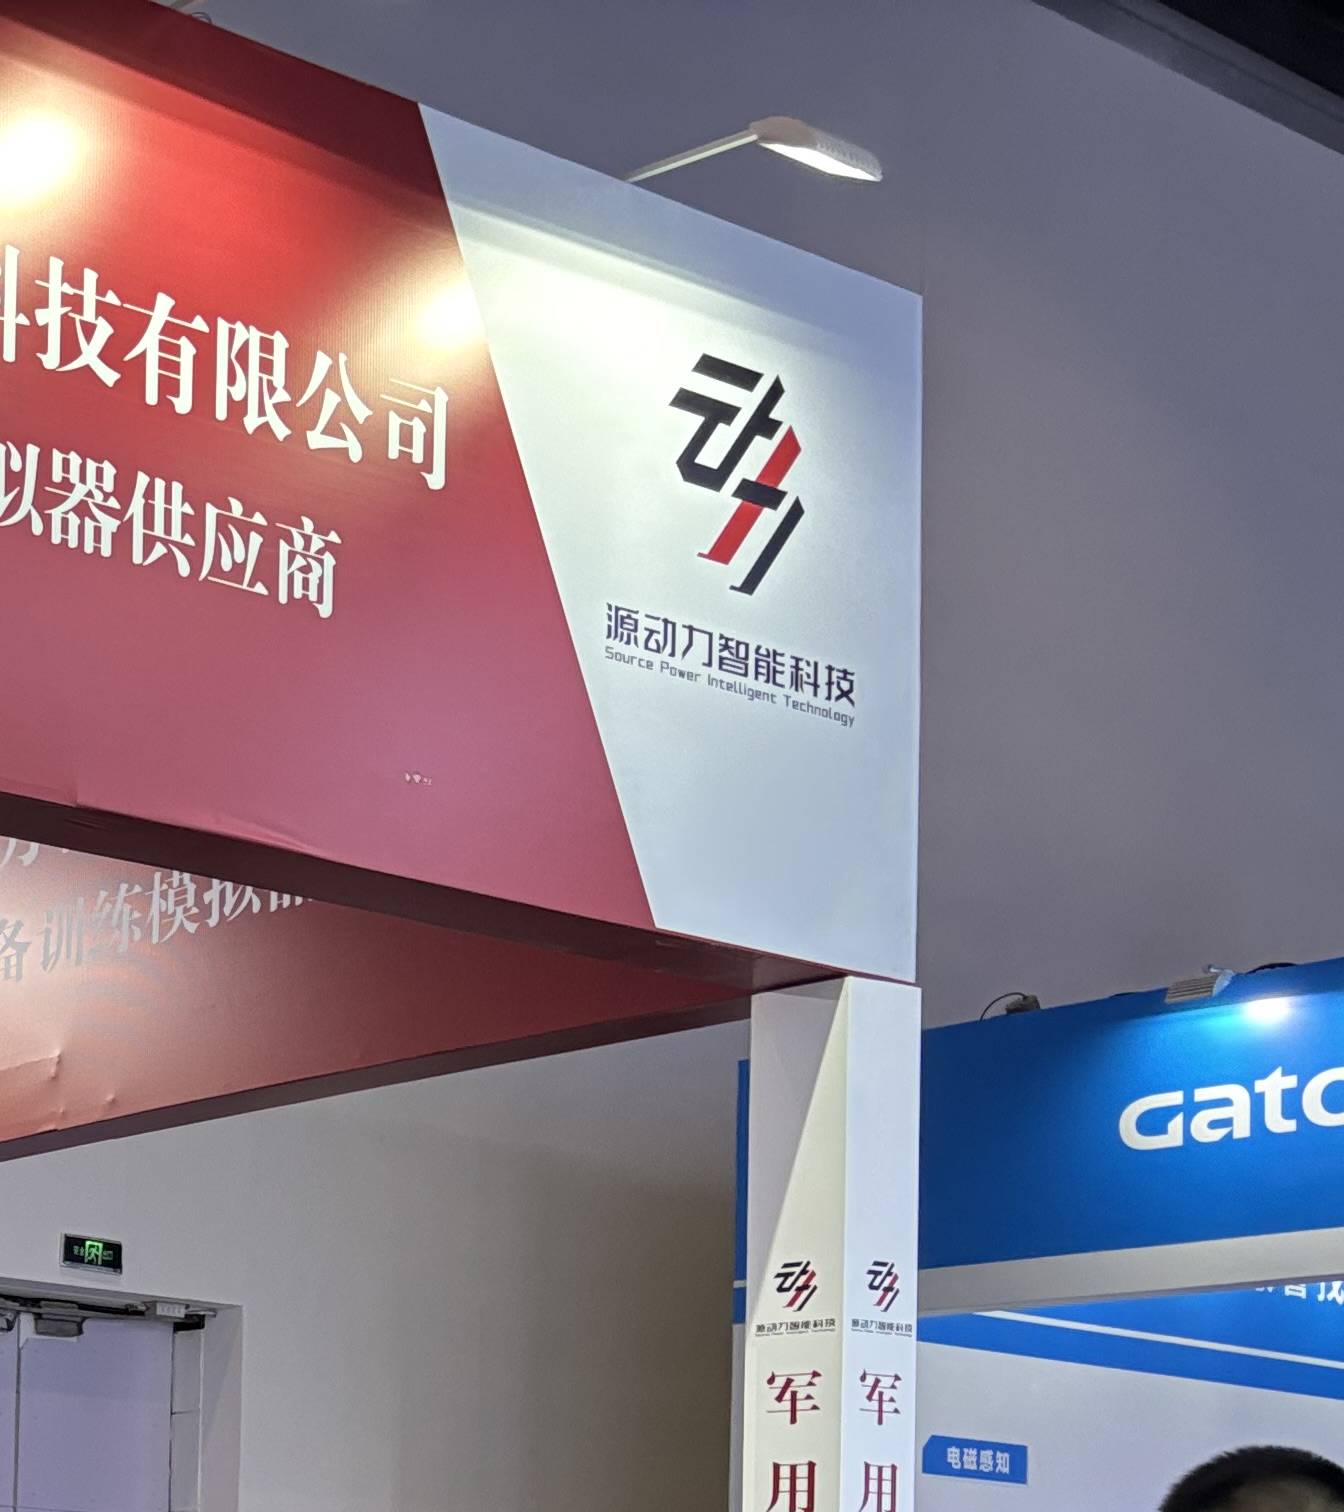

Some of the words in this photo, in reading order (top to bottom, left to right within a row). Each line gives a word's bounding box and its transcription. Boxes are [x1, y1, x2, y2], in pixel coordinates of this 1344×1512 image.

[604, 602, 856, 707] 源动力智能科技
[604, 646, 655, 672] Source
[660, 660, 702, 686] Power
[707, 672, 777, 706] Intelligent
[783, 693, 856, 728] Technology
[946, 1446, 1010, 1475] 电磁感知
